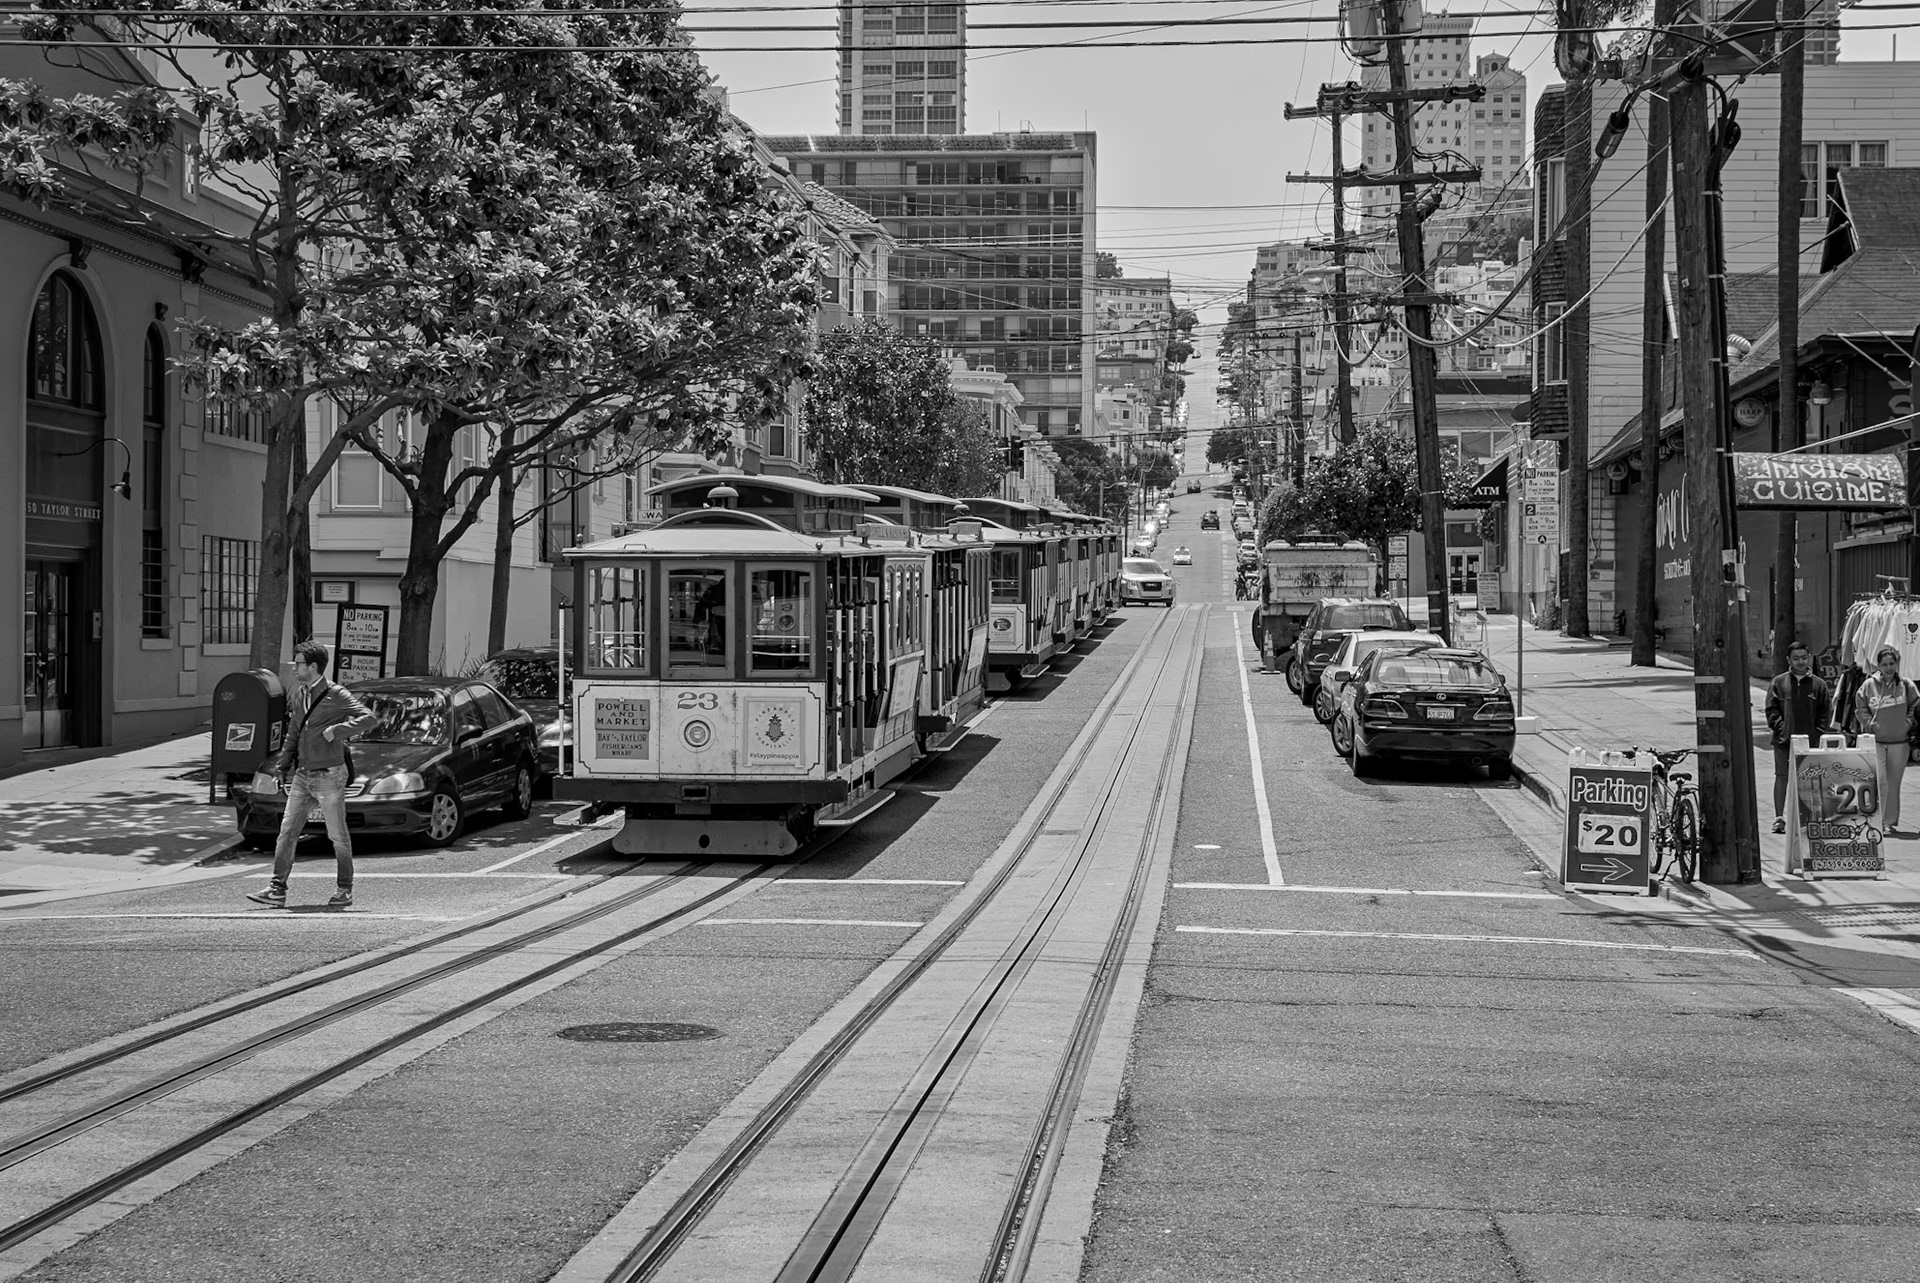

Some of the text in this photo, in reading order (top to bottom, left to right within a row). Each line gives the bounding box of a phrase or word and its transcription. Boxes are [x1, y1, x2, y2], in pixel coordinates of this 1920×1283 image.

[1526, 470, 1535, 478] NO
[1473, 486, 1500, 496] ATM
[41, 503, 70, 516] TAYLOR
[74, 507, 101, 520] STREET
[1527, 506, 1534, 515] 2
[343, 608, 382, 622] NO PARKING
[1903, 624, 1908, 634] I
[1905, 634, 1918, 644] SF
[341, 656, 350, 668] 2
[352, 664, 379, 672] PARKING
[677, 691, 719, 710] 23
[598, 703, 646, 712] POWELL
[597, 718, 648, 726] MARKET
[598, 733, 610, 742] BAY
[620, 734, 648, 742] TAYLOR
[1572, 776, 1648, 812] Parking
[1827, 784, 1878, 815] $20
[1582, 820, 1638, 846] $20
[1807, 822, 1852, 840] Bike
[1809, 840, 1878, 858] Rental
